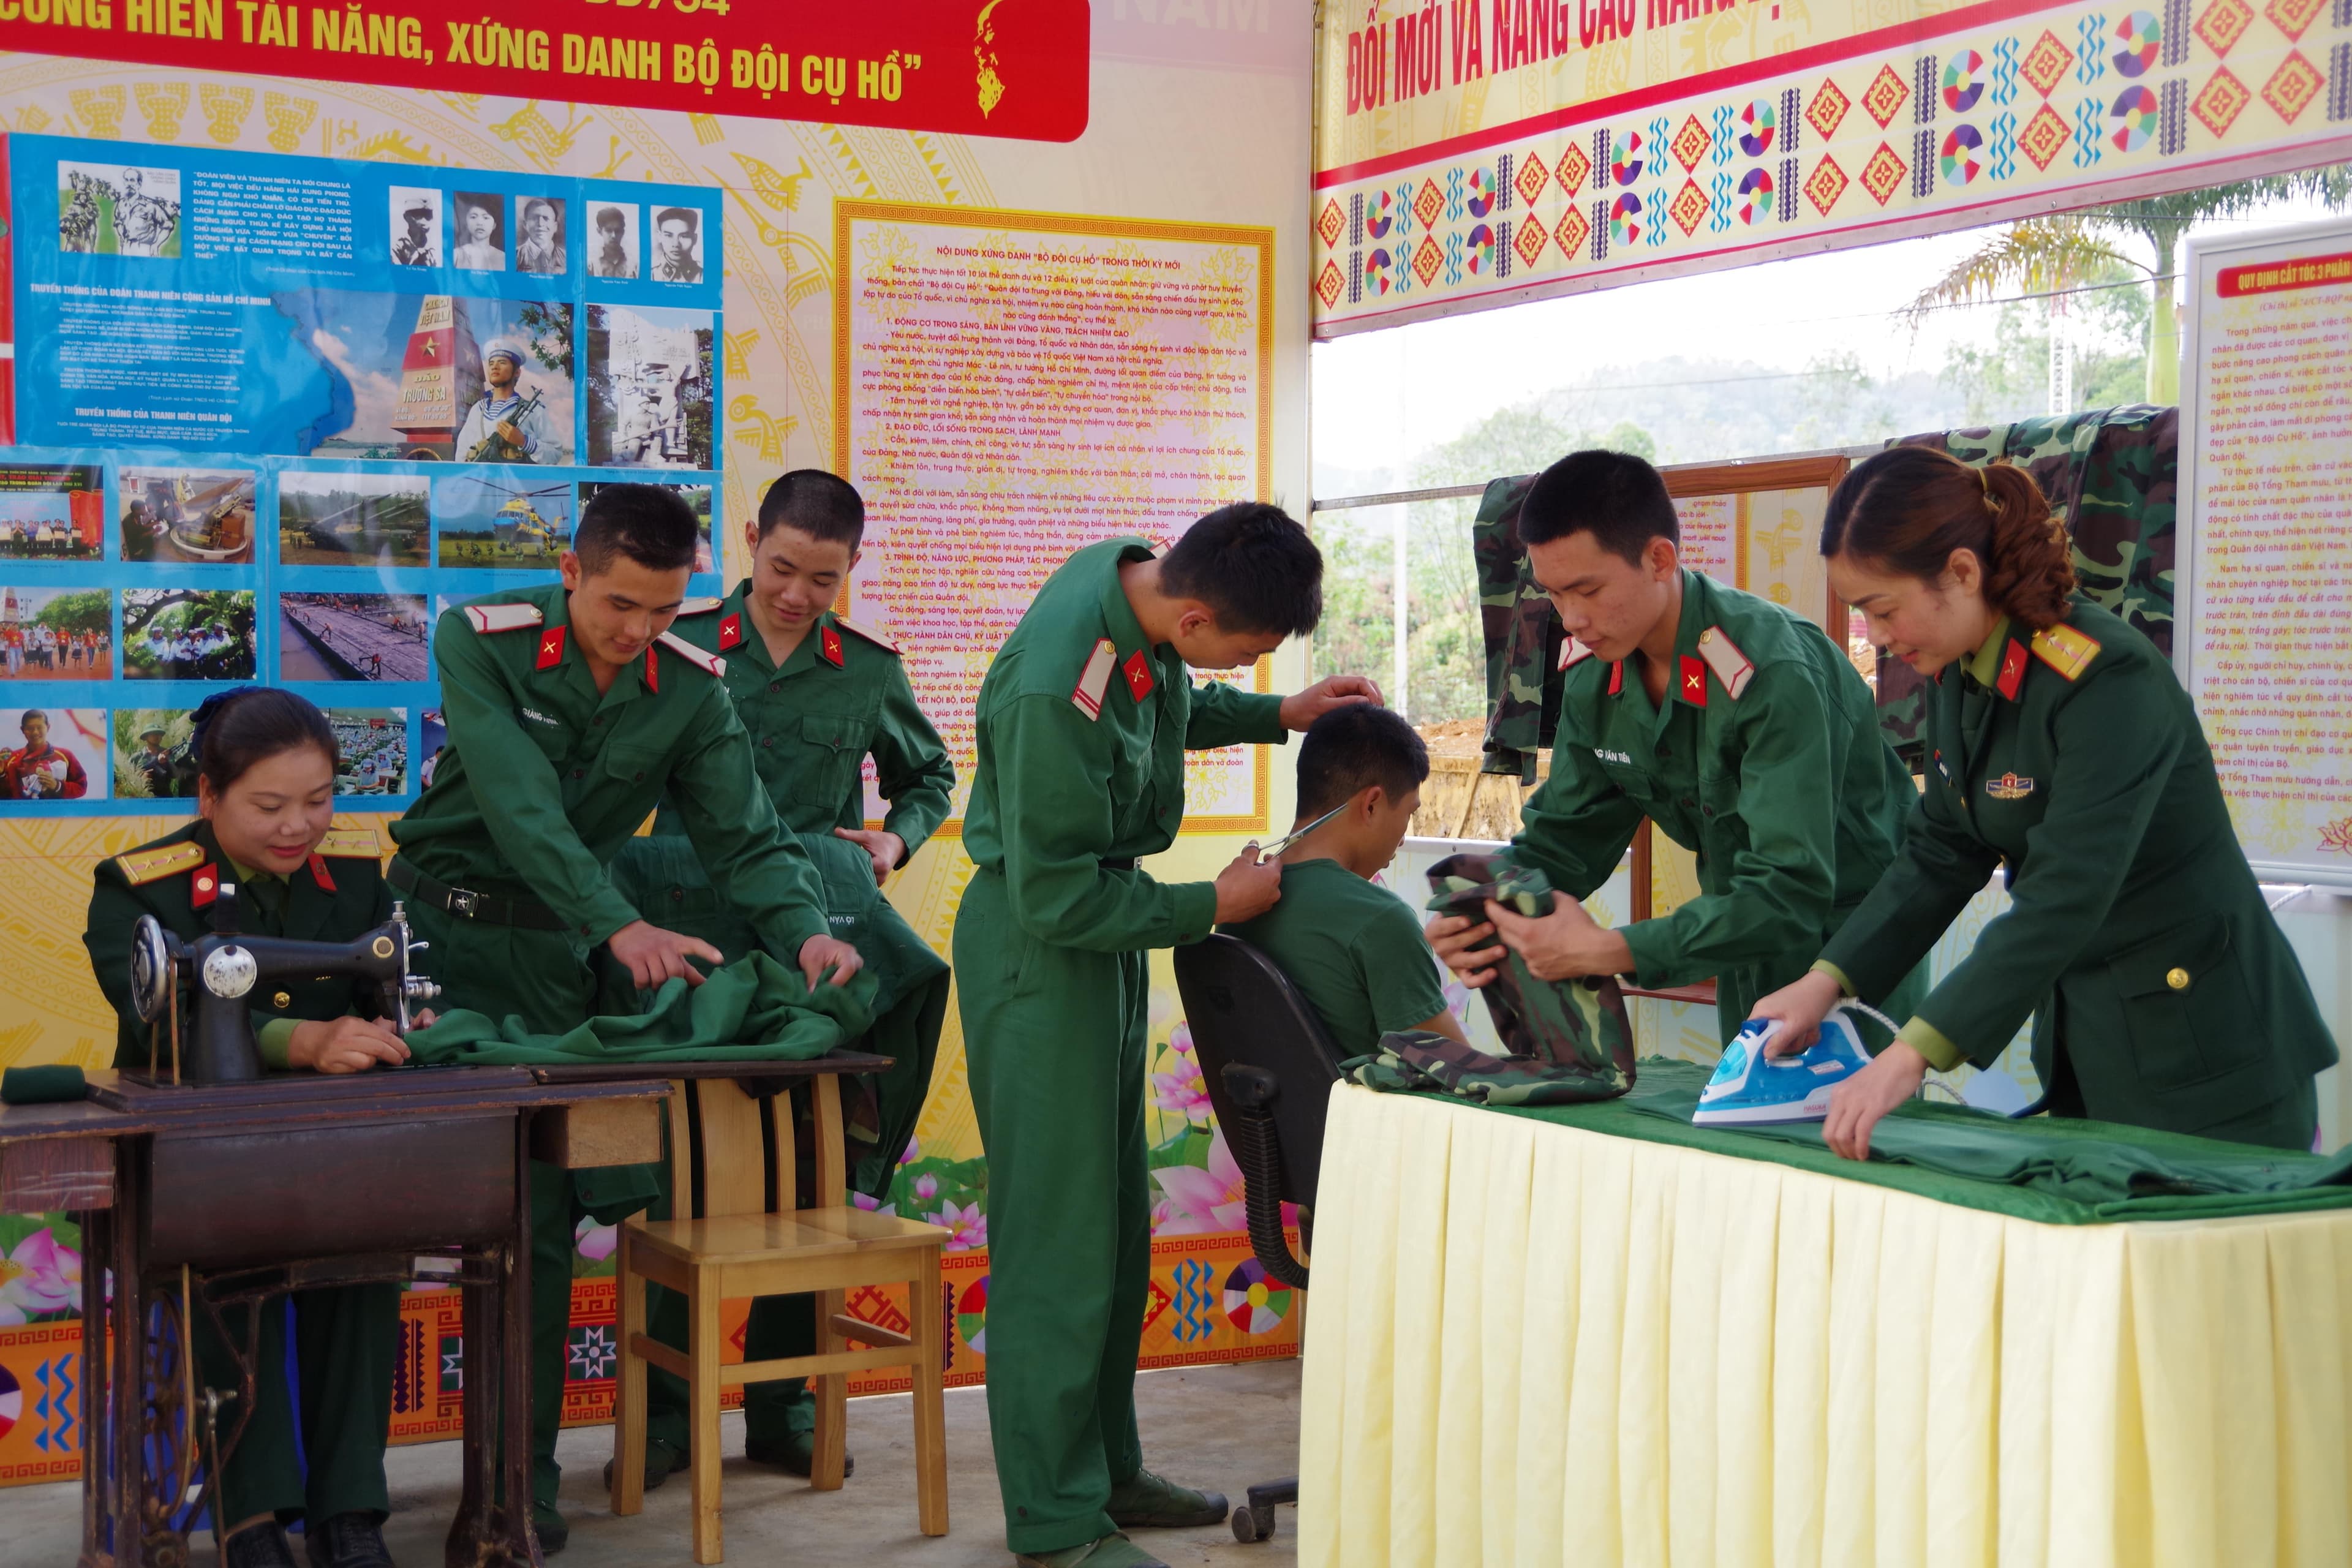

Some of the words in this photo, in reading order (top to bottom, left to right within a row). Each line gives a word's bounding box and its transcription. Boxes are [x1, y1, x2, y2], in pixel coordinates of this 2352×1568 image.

[236, 0, 297, 47] TÀI
[313, 3, 432, 66] NĂNG,
[447, 17, 549, 71] XỨNG
[564, 34, 660, 81] DANH
[674, 39, 719, 94] BỘ
[731, 43, 788, 99] ĐỘI
[802, 56, 845, 105] CỤ
[937, 244, 952, 257] NỘI
[954, 247, 979, 257] DUNG
[981, 248, 1005, 258] XỨNG
[1007, 251, 1031, 260] DANH
[1051, 252, 1066, 263] ĐỘI
[1068, 255, 1080, 265] CỤ
[1101, 257, 1129, 266] TRONG
[1131, 258, 1150, 268] THỜI
[1152, 258, 1163, 268] KỲ
[1164, 260, 1180, 270] MỚI
[30, 282, 61, 293] TRUYỀN
[63, 284, 89, 294] THỐNG
[91, 286, 108, 295] CỦA
[110, 287, 131, 296] ĐOÀN
[134, 289, 159, 298] THANH
[161, 290, 180, 299] NIÊN
[182, 291, 203, 301] CỘNG
[205, 292, 221, 302] SẢN
[222, 293, 233, 303] HỒ
[235, 295, 248, 304] CHÍ
[250, 296, 270, 305] MINH
[894, 317, 917, 326] ĐỘNG
[932, 320, 958, 328] TRONG
[959, 320, 982, 330] SÁNG,
[984, 321, 998, 330] BẢN
[1000, 322, 1016, 331] LĨNH
[1018, 323, 1038, 333] VỮNG
[1040, 325, 1063, 334] VÀNG,
[1065, 326, 1088, 335] TRÁCH
[1090, 328, 1111, 336] NHIỆM
[75, 406, 104, 416] TRUYỀN
[106, 407, 131, 417] THỐNG
[134, 407, 148, 418] CỦA
[151, 410, 175, 419] THANH
[177, 410, 195, 420] NIÊN
[197, 412, 217, 421] QUÂN
[219, 412, 232, 423] ĐỘI
[894, 423, 911, 431] ĐẠO
[913, 422, 930, 432] ĐỨC,
[933, 423, 944, 432] LỐI
[946, 424, 967, 432] SỐNG
[1019, 426, 1037, 435] LÀNH
[862, 447, 876, 456] của
[878, 448, 900, 458] Đảng,
[961, 451, 973, 461] đội
[916, 552, 929, 562] ĐỘ,
[931, 553, 953, 562] NĂNG
[955, 554, 971, 564] LỰC,
[1005, 555, 1025, 564] PHÁP,
[1027, 555, 1041, 564] TÁC
[914, 630, 935, 639] HÀNH
[937, 630, 952, 639] DÂN
[954, 630, 972, 640] CHỦ,
[974, 630, 984, 639] KỶ
[986, 631, 1001, 639] LUẬT
[930, 695, 944, 705] NỘI
[946, 695, 958, 704] BỘ,
